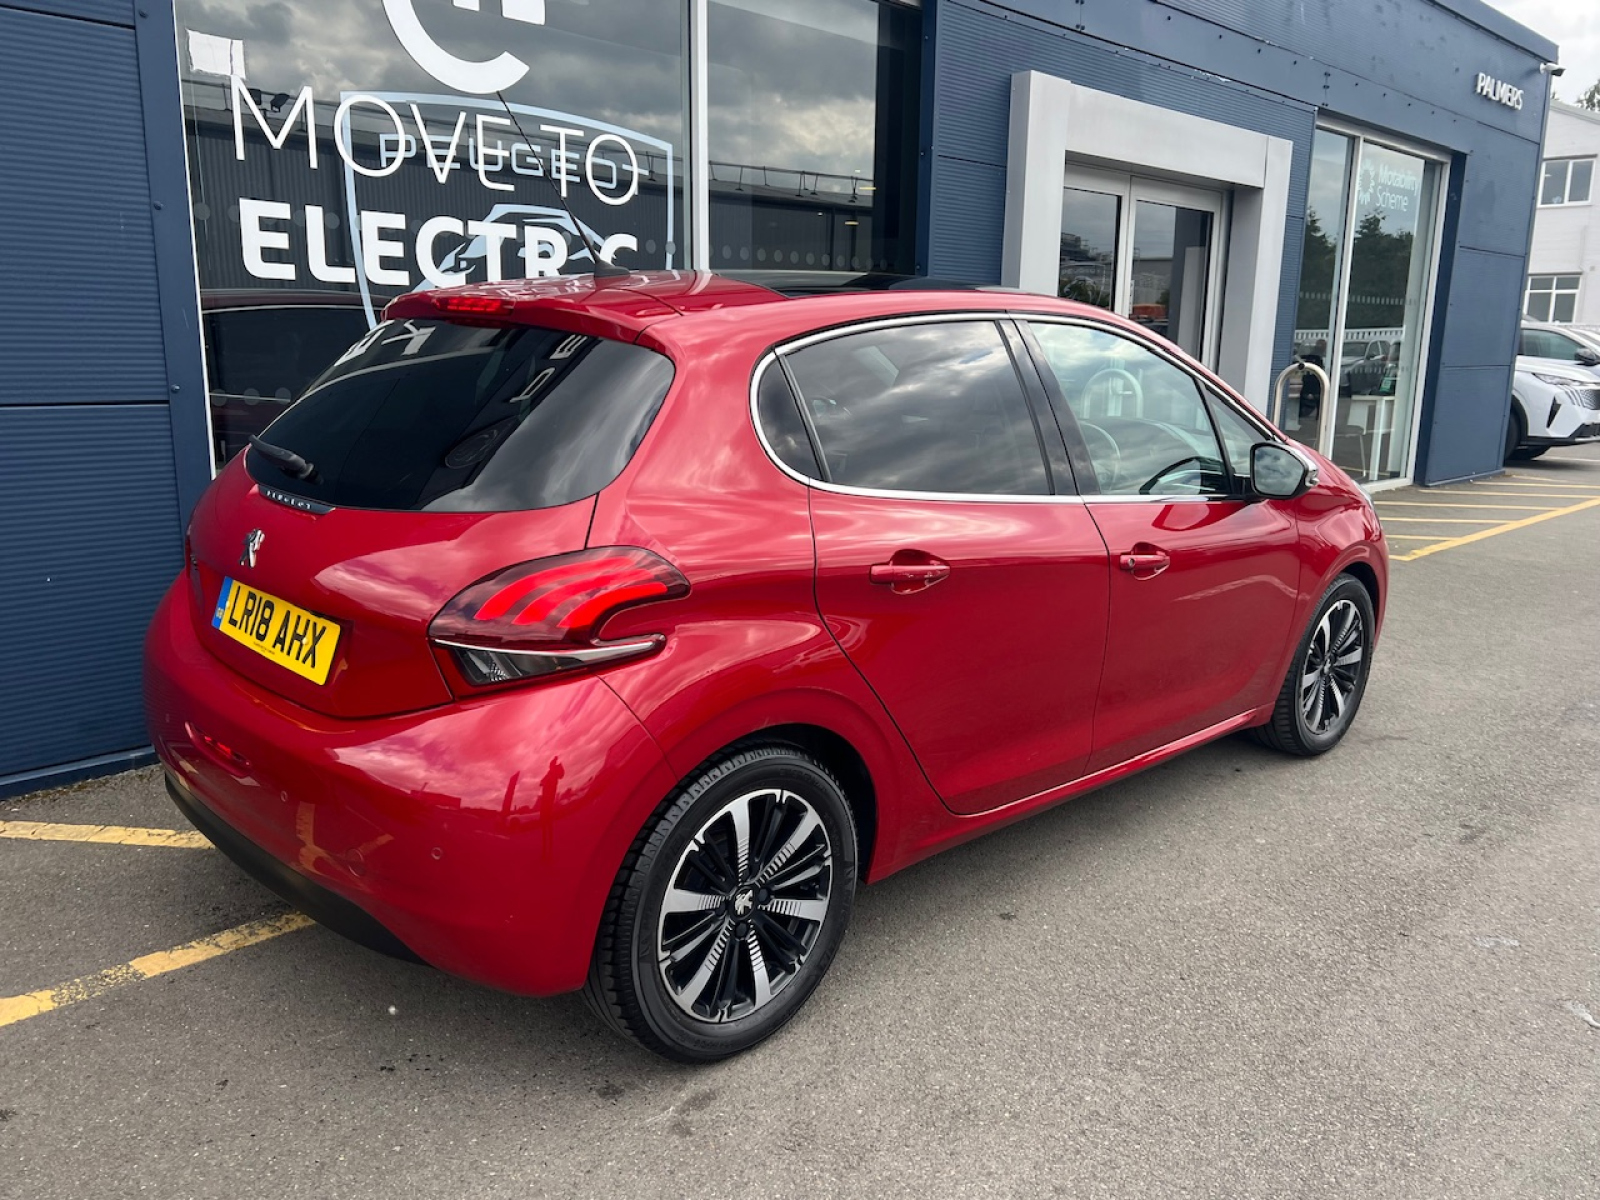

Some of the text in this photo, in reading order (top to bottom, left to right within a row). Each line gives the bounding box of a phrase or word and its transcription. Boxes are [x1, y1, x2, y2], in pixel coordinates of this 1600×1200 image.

[1476, 72, 1524, 110] PALMERS
[231, 75, 639, 206] MOVE TO
[379, 133, 649, 196] PEUGEOT
[1376, 186, 1408, 211] Scheme
[1379, 164, 1417, 196] Motability
[228, 585, 327, 669] LR18 AHX
